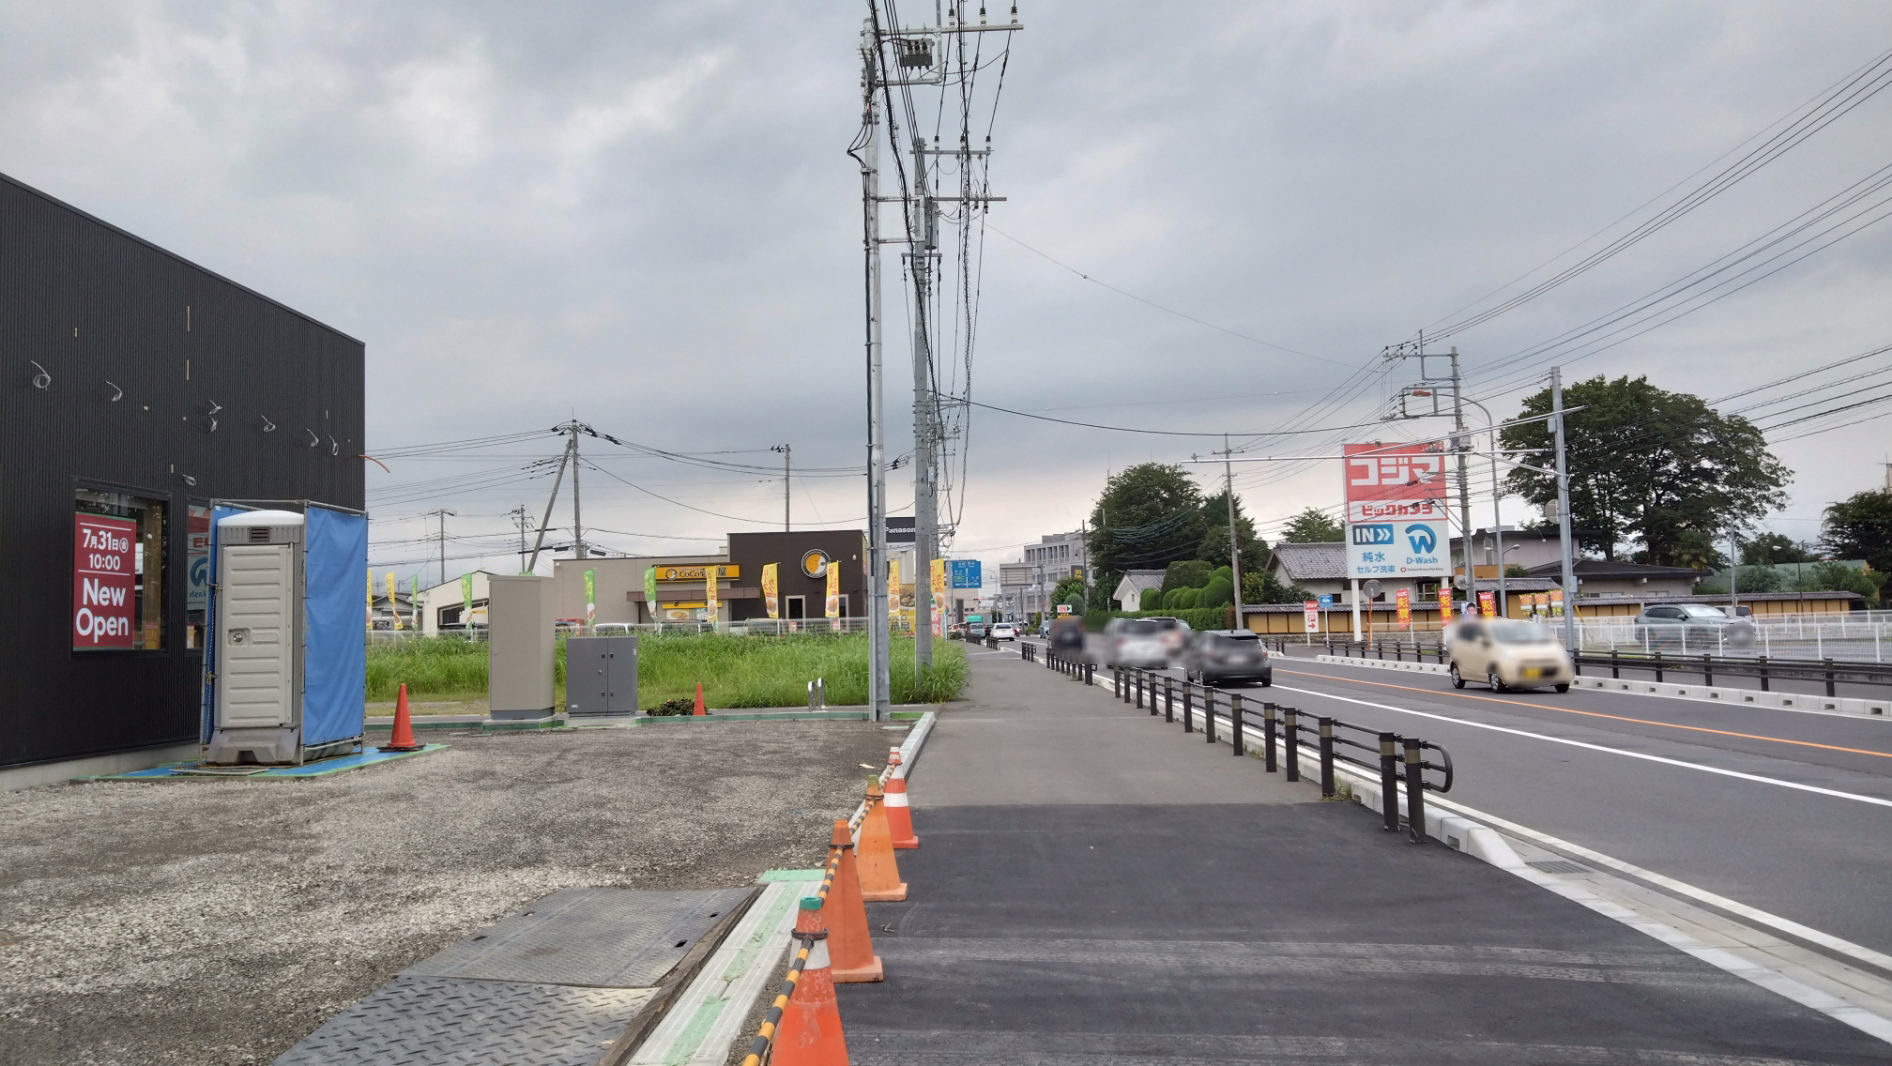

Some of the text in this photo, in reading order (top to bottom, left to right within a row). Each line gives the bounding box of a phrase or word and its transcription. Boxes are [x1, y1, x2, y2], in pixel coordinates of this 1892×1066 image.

[1350, 456, 1440, 486] コジマ
[1361, 504, 1433, 517] ビックカメラ
[886, 526, 916, 534] Panason
[1355, 527, 1375, 543] IN
[89, 553, 121, 571] 10:00
[1362, 551, 1386, 563] 純水
[1406, 556, 1438, 565] D-Wash
[1356, 565, 1396, 574] セルフ洗車
[83, 578, 126, 606] New
[76, 608, 129, 643] Open
